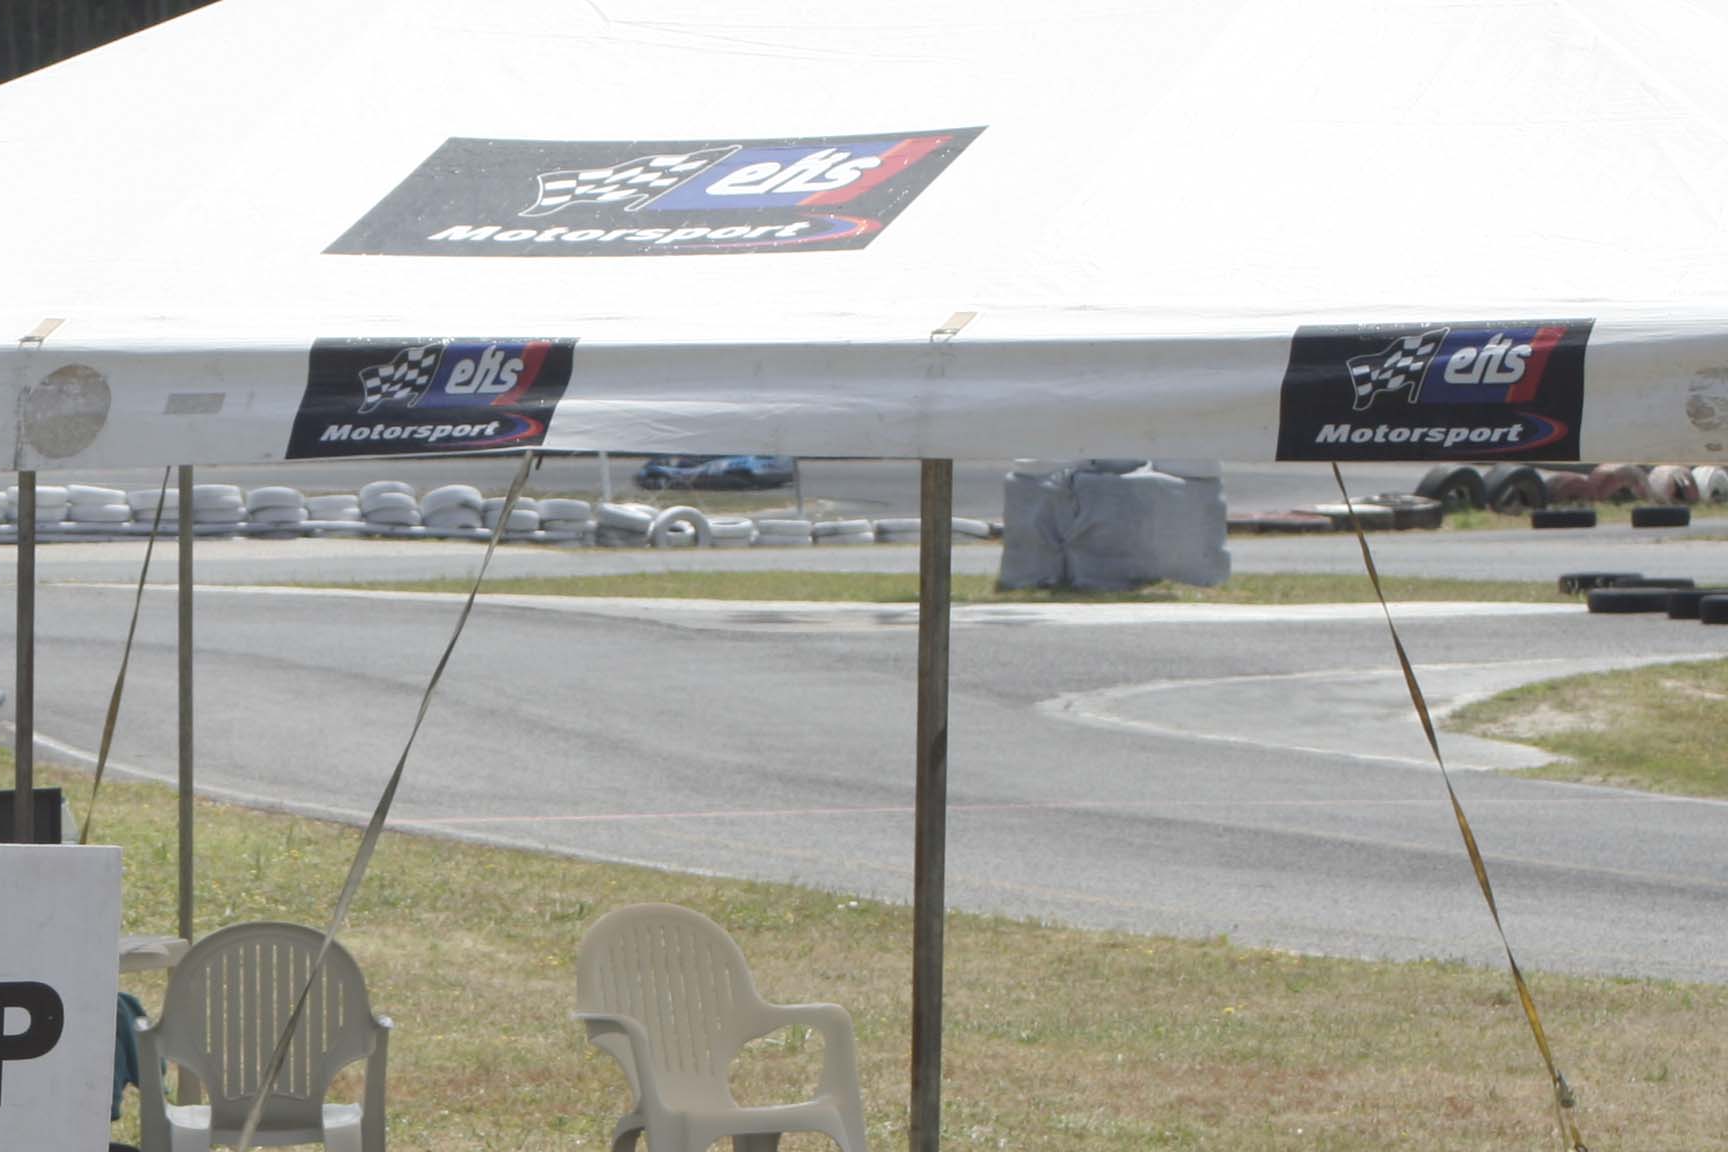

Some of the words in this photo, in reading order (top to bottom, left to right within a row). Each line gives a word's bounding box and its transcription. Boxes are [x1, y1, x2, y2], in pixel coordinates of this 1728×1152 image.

[429, 219, 811, 247] Motorsport
[320, 416, 499, 444] Motorsport
[1315, 423, 1524, 448] Motorsport
